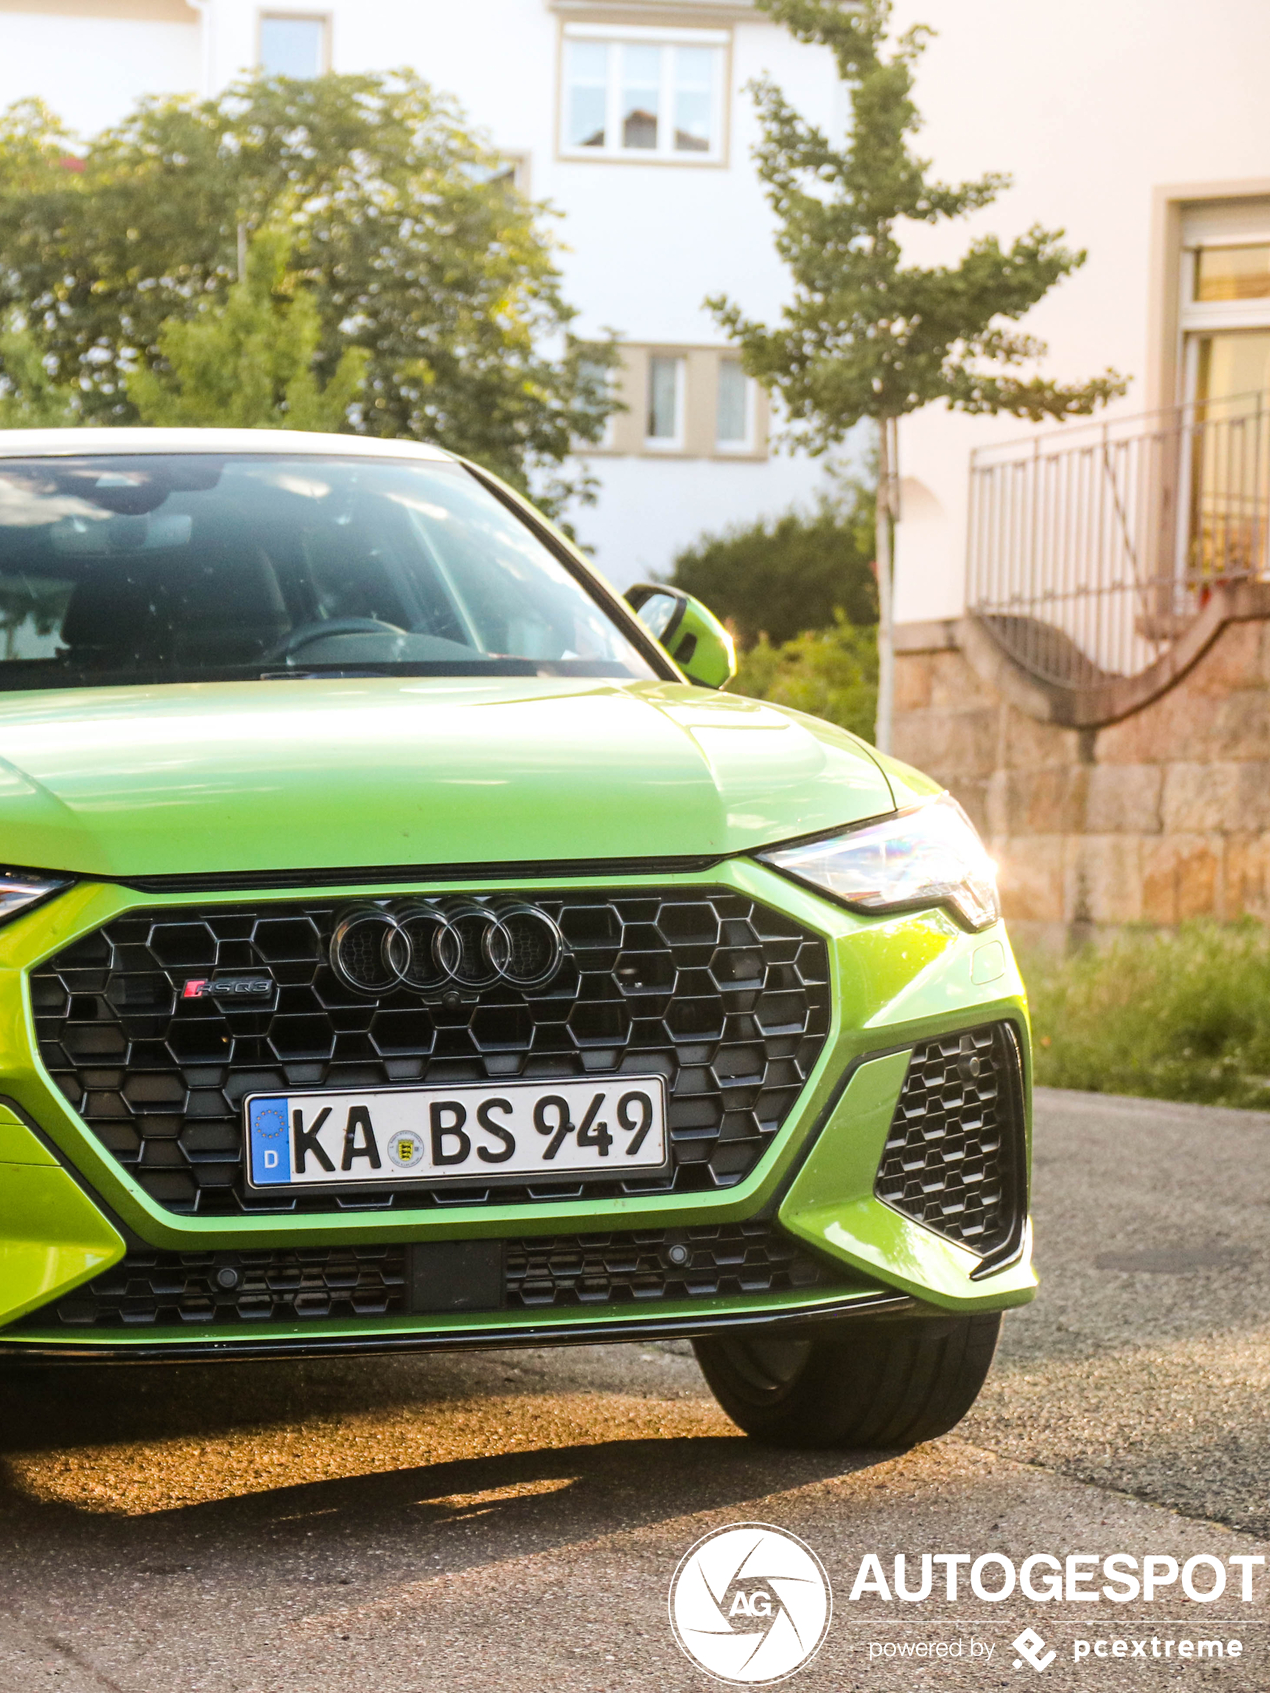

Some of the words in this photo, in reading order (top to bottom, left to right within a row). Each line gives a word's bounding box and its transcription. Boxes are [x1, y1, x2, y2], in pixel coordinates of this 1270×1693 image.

[264, 1150, 279, 1169] D
[292, 1105, 383, 1174] KA
[429, 1097, 516, 1166] BS
[533, 1090, 654, 1160] 949
